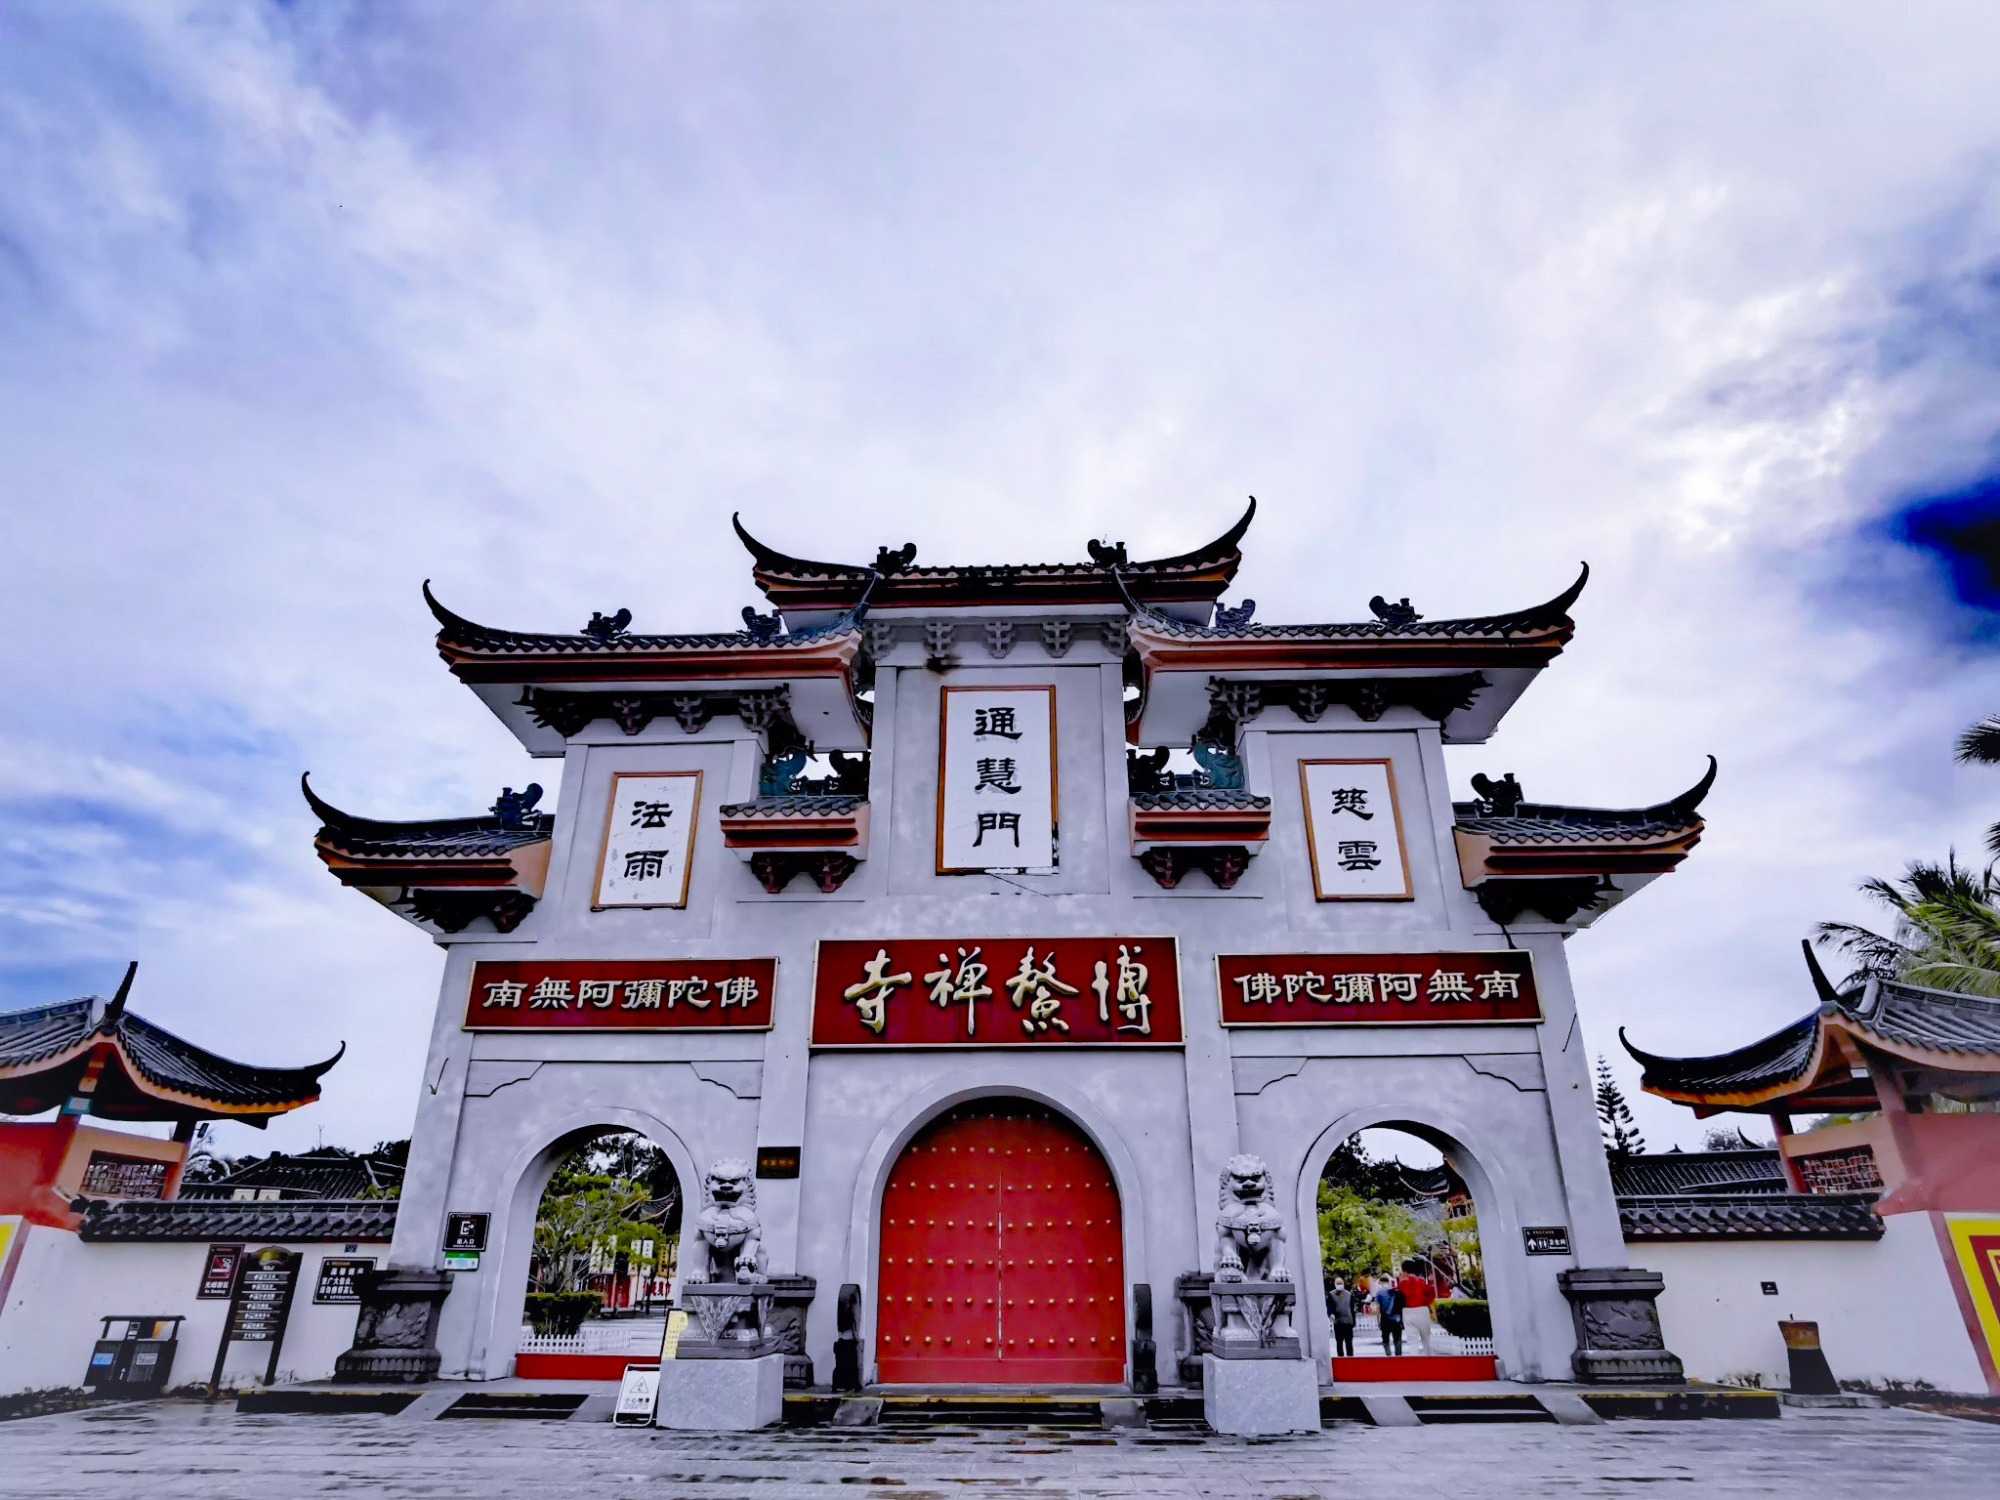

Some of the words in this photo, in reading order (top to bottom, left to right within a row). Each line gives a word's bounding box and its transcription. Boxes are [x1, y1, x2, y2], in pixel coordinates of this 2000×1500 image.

[972, 706, 1024, 849] 通慧門
[623, 800, 674, 882] 法雨
[1331, 787, 1382, 872] 慈雲
[483, 976, 759, 1009] 南無阿彌陀佛
